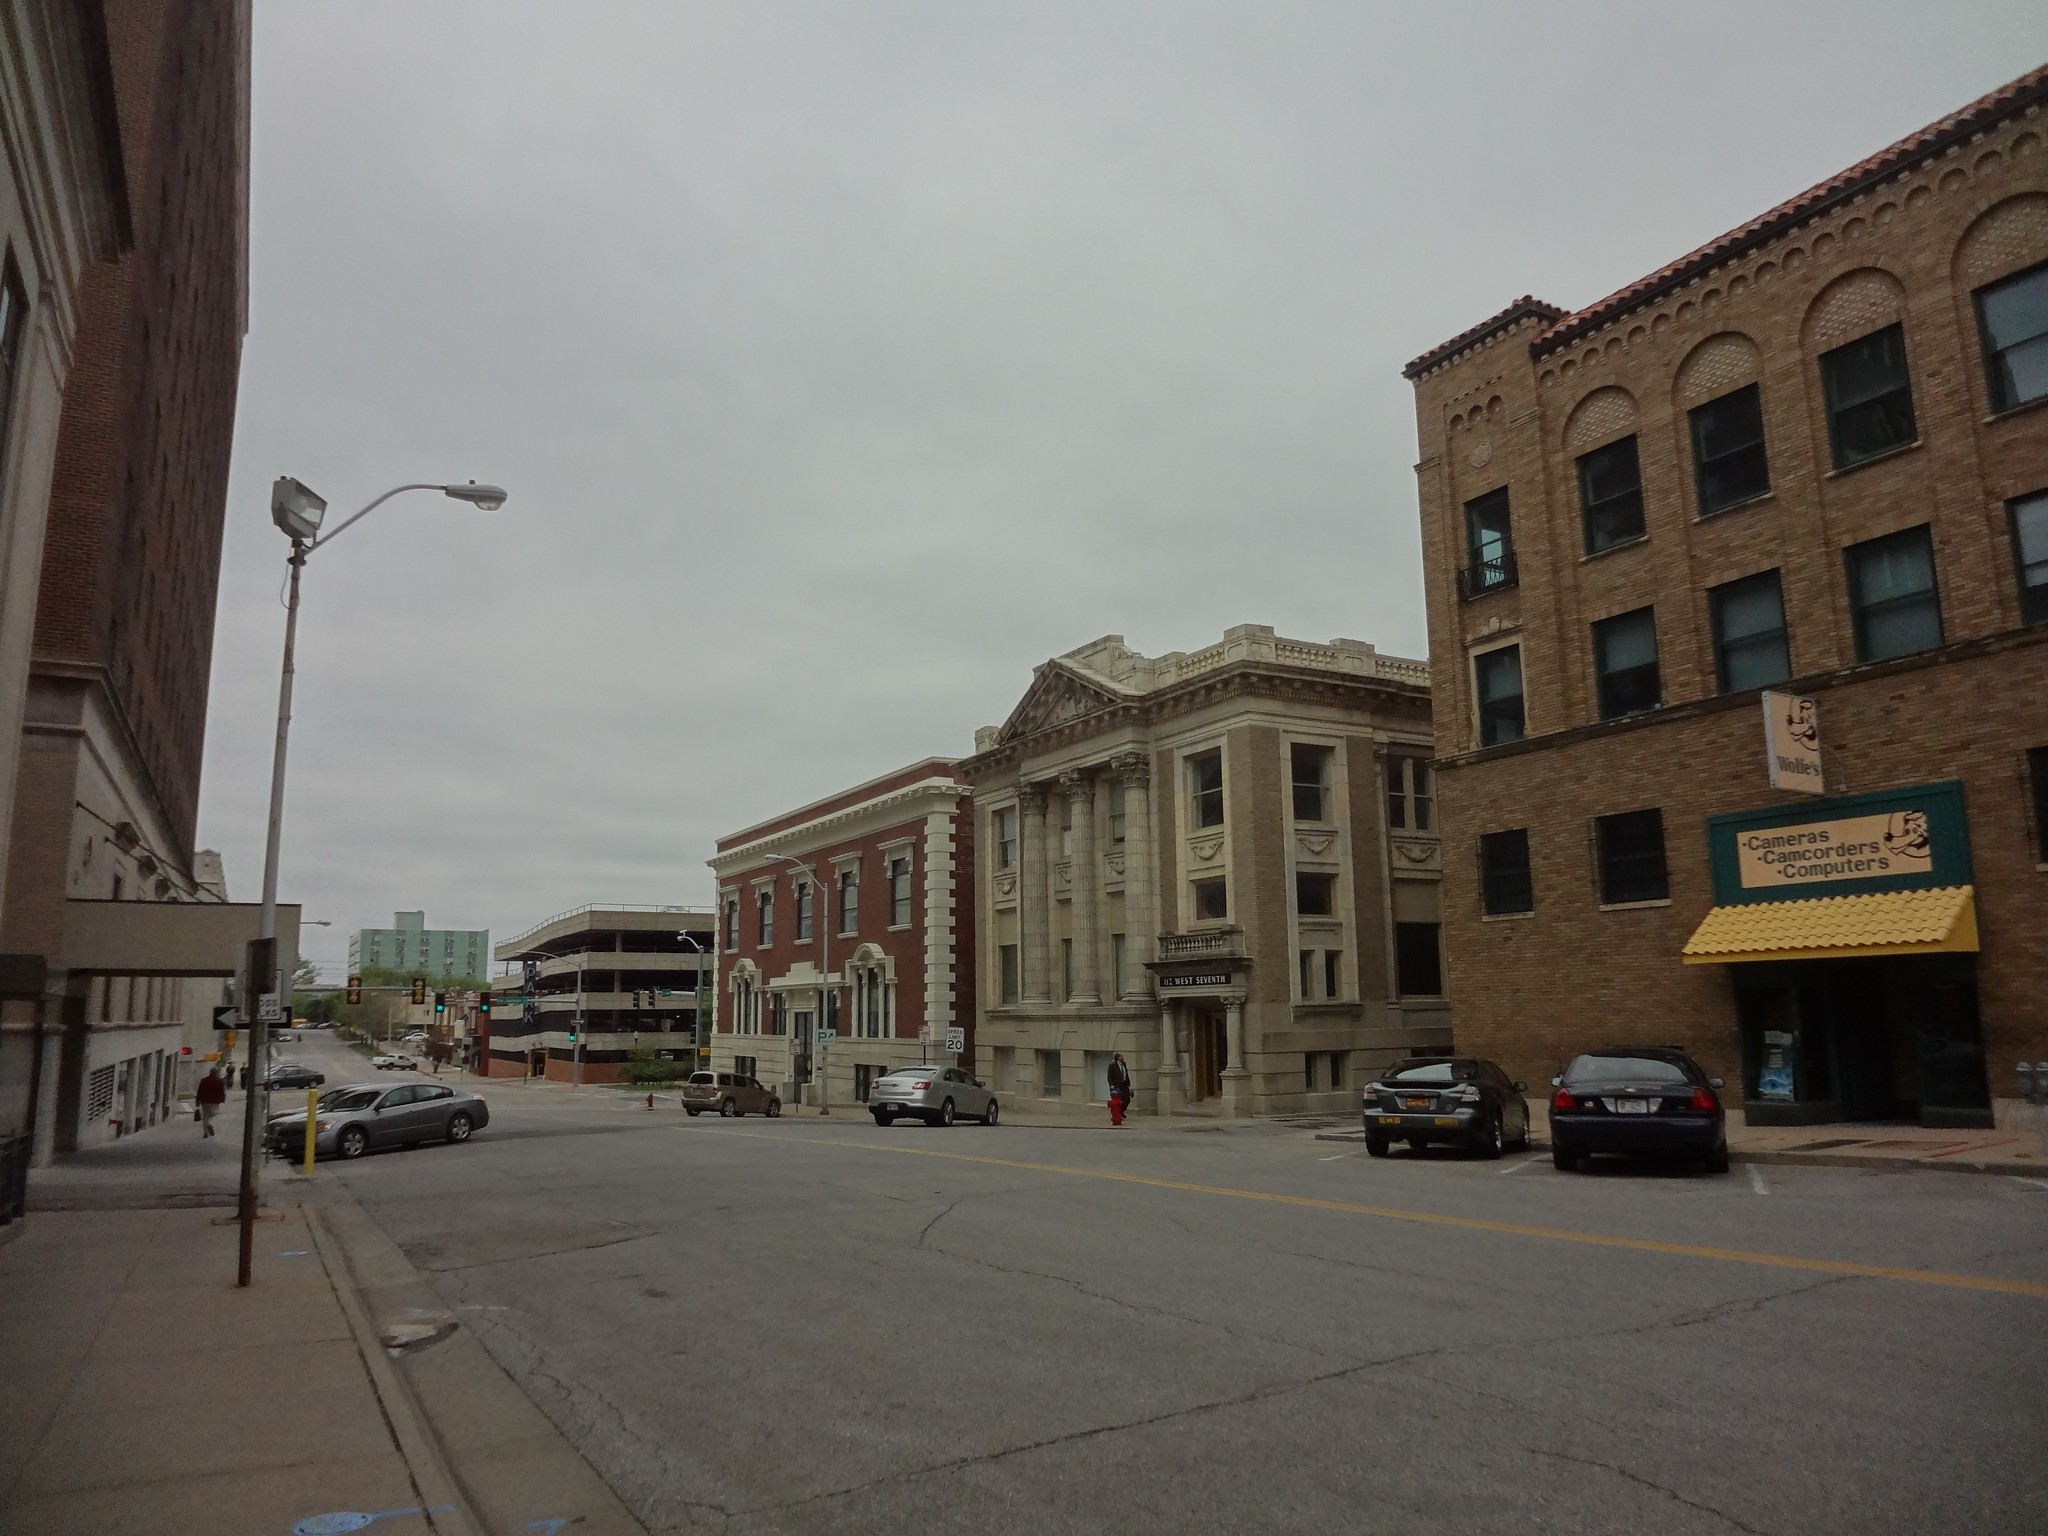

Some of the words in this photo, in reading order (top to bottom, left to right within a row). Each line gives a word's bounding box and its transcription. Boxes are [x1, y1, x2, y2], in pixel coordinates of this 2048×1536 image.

[1777, 756, 1819, 776] Wolfe's
[1748, 830, 1829, 851] Cameras
[1763, 842, 1880, 864] Camcorders
[1783, 856, 1889, 878] Computers
[1174, 976, 1193, 985] WEST
[1195, 975, 1226, 984] SEVENTH
[818, 1031, 827, 1043] P
[947, 1040, 962, 1050] 20
